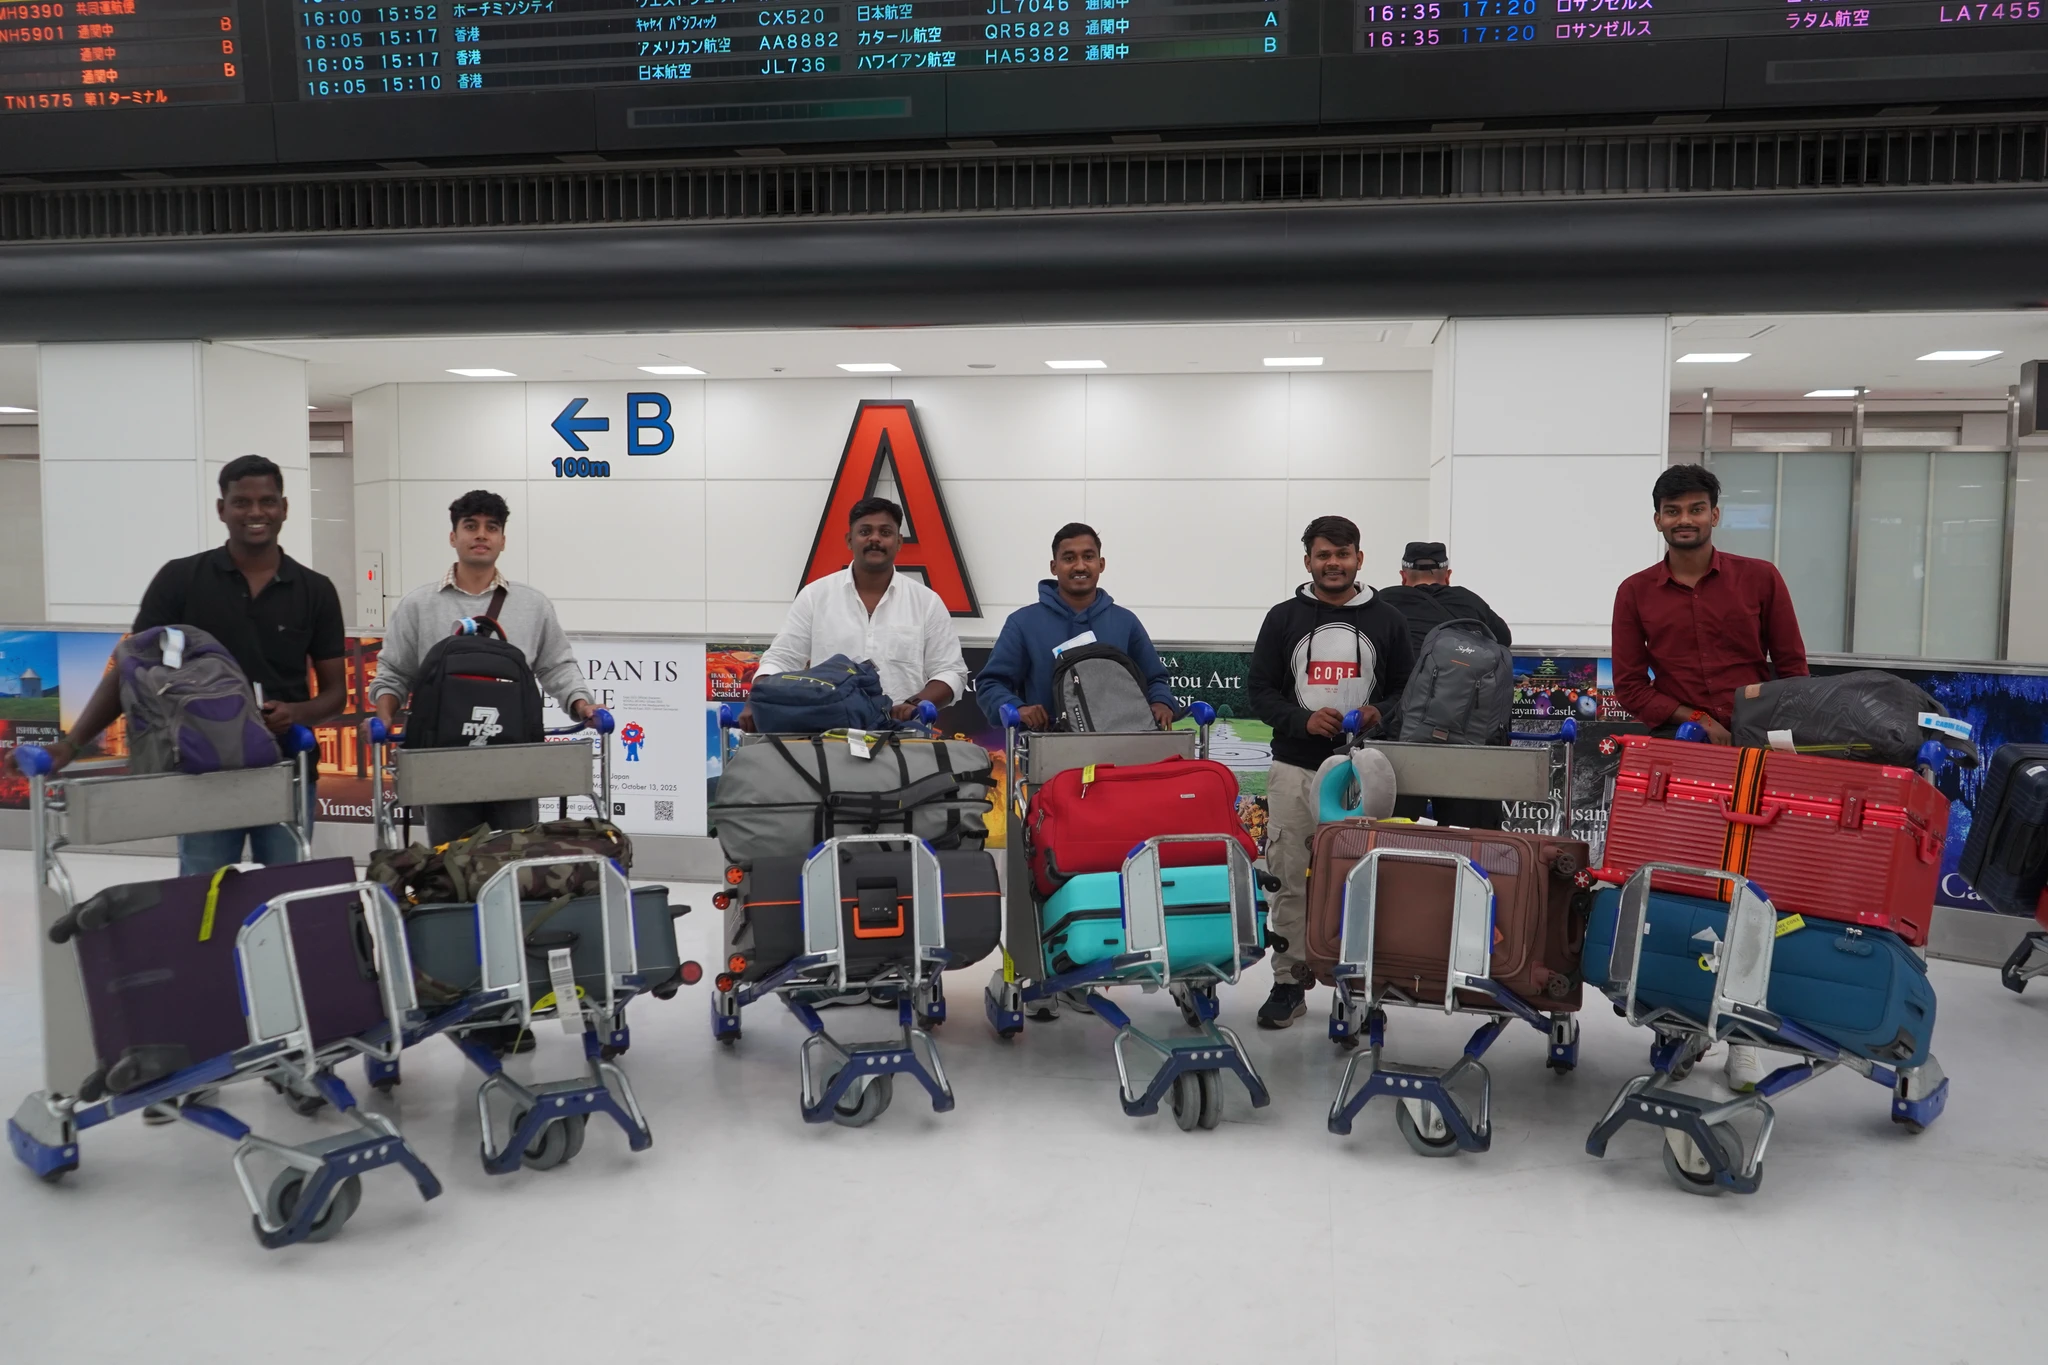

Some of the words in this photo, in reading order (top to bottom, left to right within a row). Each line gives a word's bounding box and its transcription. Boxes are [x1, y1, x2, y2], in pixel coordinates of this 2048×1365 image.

[303, 9, 361, 27] 16:00
[378, 4, 437, 22] 15:52
[453, 0, 554, 18] ホーチミンシティ
[758, 8, 824, 27] CX520
[857, 3, 913, 22] 日本航空
[1368, 2, 1441, 22] 16:35
[1462, 0, 1536, 18] 17:20
[0, 26, 64, 43] NH5901
[77, 23, 114, 39] 通関中
[220, 16, 232, 31] B
[637, 37, 731, 56] アメリカン航空
[759, 31, 838, 51] AA8882
[858, 26, 942, 46] カタール航空
[985, 20, 1070, 40] QR5828
[1085, 17, 1130, 36] 通関中
[1264, 11, 1278, 27] A
[1368, 29, 1439, 48] 16:35
[1462, 24, 1535, 44] 17:20
[1556, 20, 1652, 39] ロサンゼルス
[1786, 9, 1870, 29] ラタム航空
[1940, 1, 2041, 23] LA7455
[305, 32, 363, 50] 16:05
[379, 28, 437, 46] 15:17
[454, 26, 480, 43] 香港
[79, 46, 116, 62] 通関中
[221, 39, 234, 55] B
[307, 55, 365, 73] 16:05
[381, 51, 439, 69] 15:17
[456, 49, 482, 66] 香港
[639, 62, 692, 81] 日本航空
[761, 57, 825, 75] JL736
[857, 50, 956, 70] ハワイアン航空
[985, 46, 1069, 65] HA5382
[1085, 42, 1129, 61] 通関中
[1264, 36, 1277, 53] B
[81, 68, 119, 85] 通関中
[223, 62, 236, 77] B
[308, 79, 366, 96] 16:05
[382, 75, 441, 92] 15:10
[457, 72, 483, 89] 香港
[4, 93, 73, 109] TN1575
[627, 392, 675, 456] B
[551, 457, 610, 478] 100m
[795, 399, 984, 619] A
[653, 660, 678, 683] IS
[1206, 670, 1242, 689] Art
[711, 679, 742, 689] Hitachi
[711, 688, 741, 698] Seaside
[1546, 705, 1577, 716] Castle
[461, 722, 503, 737] RYSP
[621, 782, 647, 791] October
[649, 783, 659, 792] 13,
[660, 784, 678, 792] 2025
